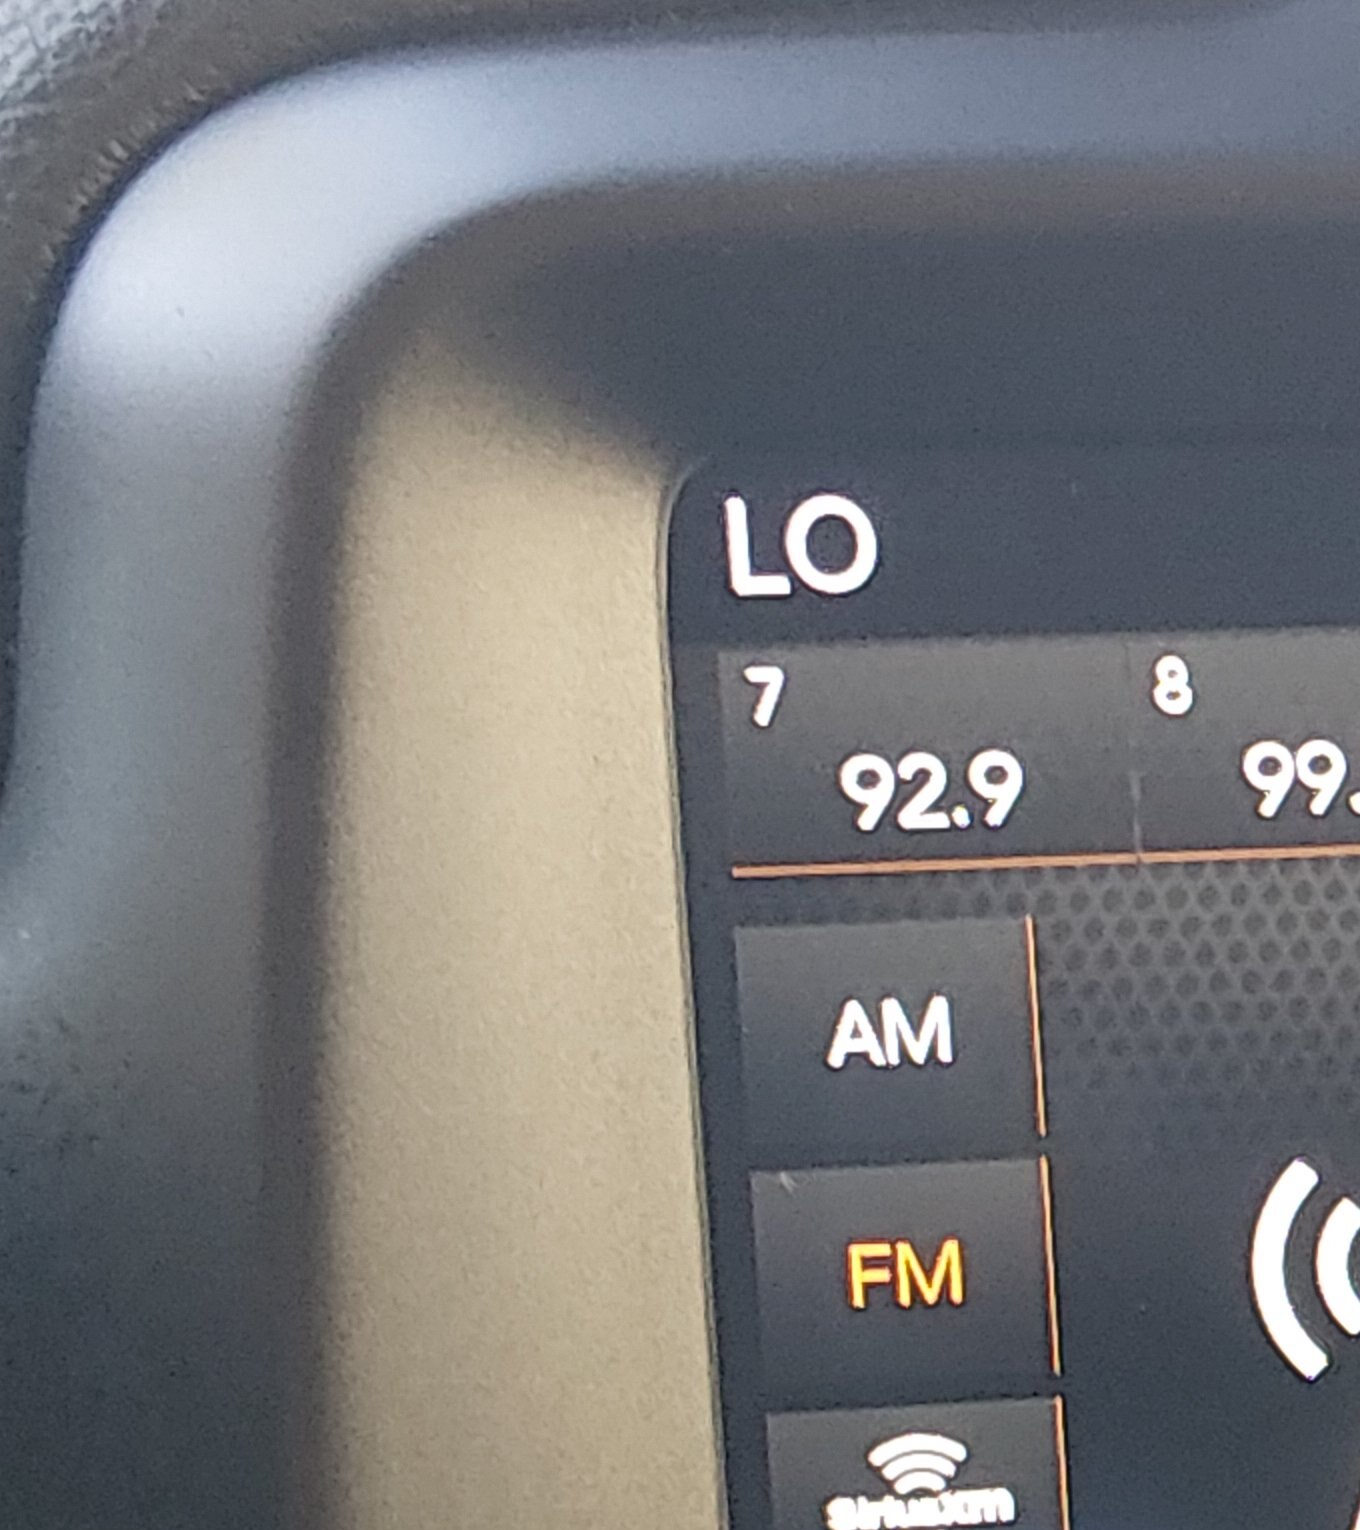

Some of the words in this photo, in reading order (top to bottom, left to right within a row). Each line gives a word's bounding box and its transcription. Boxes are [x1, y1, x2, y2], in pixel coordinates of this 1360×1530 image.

[724, 494, 877, 597] LO
[743, 666, 785, 727] 7
[1152, 655, 1193, 715] 8
[839, 749, 1023, 831] 92.9
[827, 995, 953, 1068] AM
[847, 1238, 963, 1309] FM
